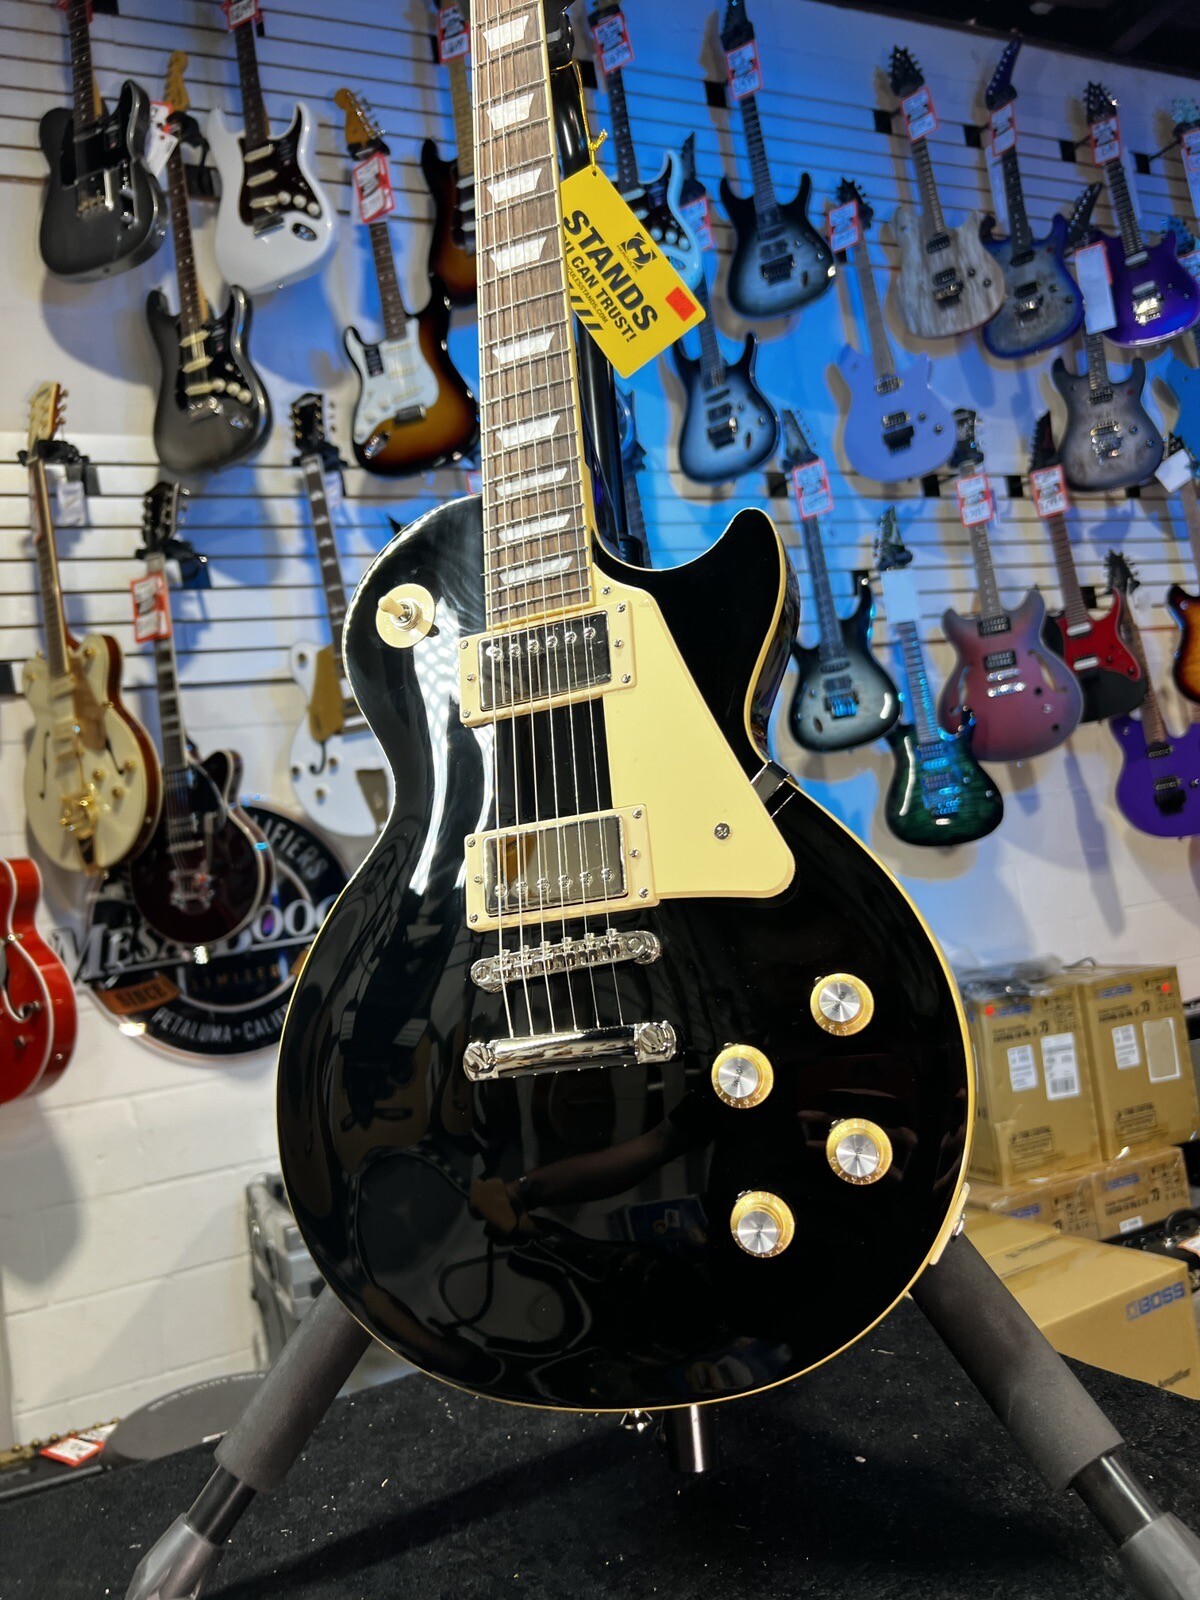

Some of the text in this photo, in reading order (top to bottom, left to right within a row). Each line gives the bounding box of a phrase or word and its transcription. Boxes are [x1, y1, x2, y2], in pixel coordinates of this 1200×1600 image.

[563, 210, 658, 331] STANDS
[571, 255, 638, 343] CAN TRUST!
[151, 1003, 289, 1043] PETALUMA CALIF
[1136, 1281, 1187, 1317] BOSS
